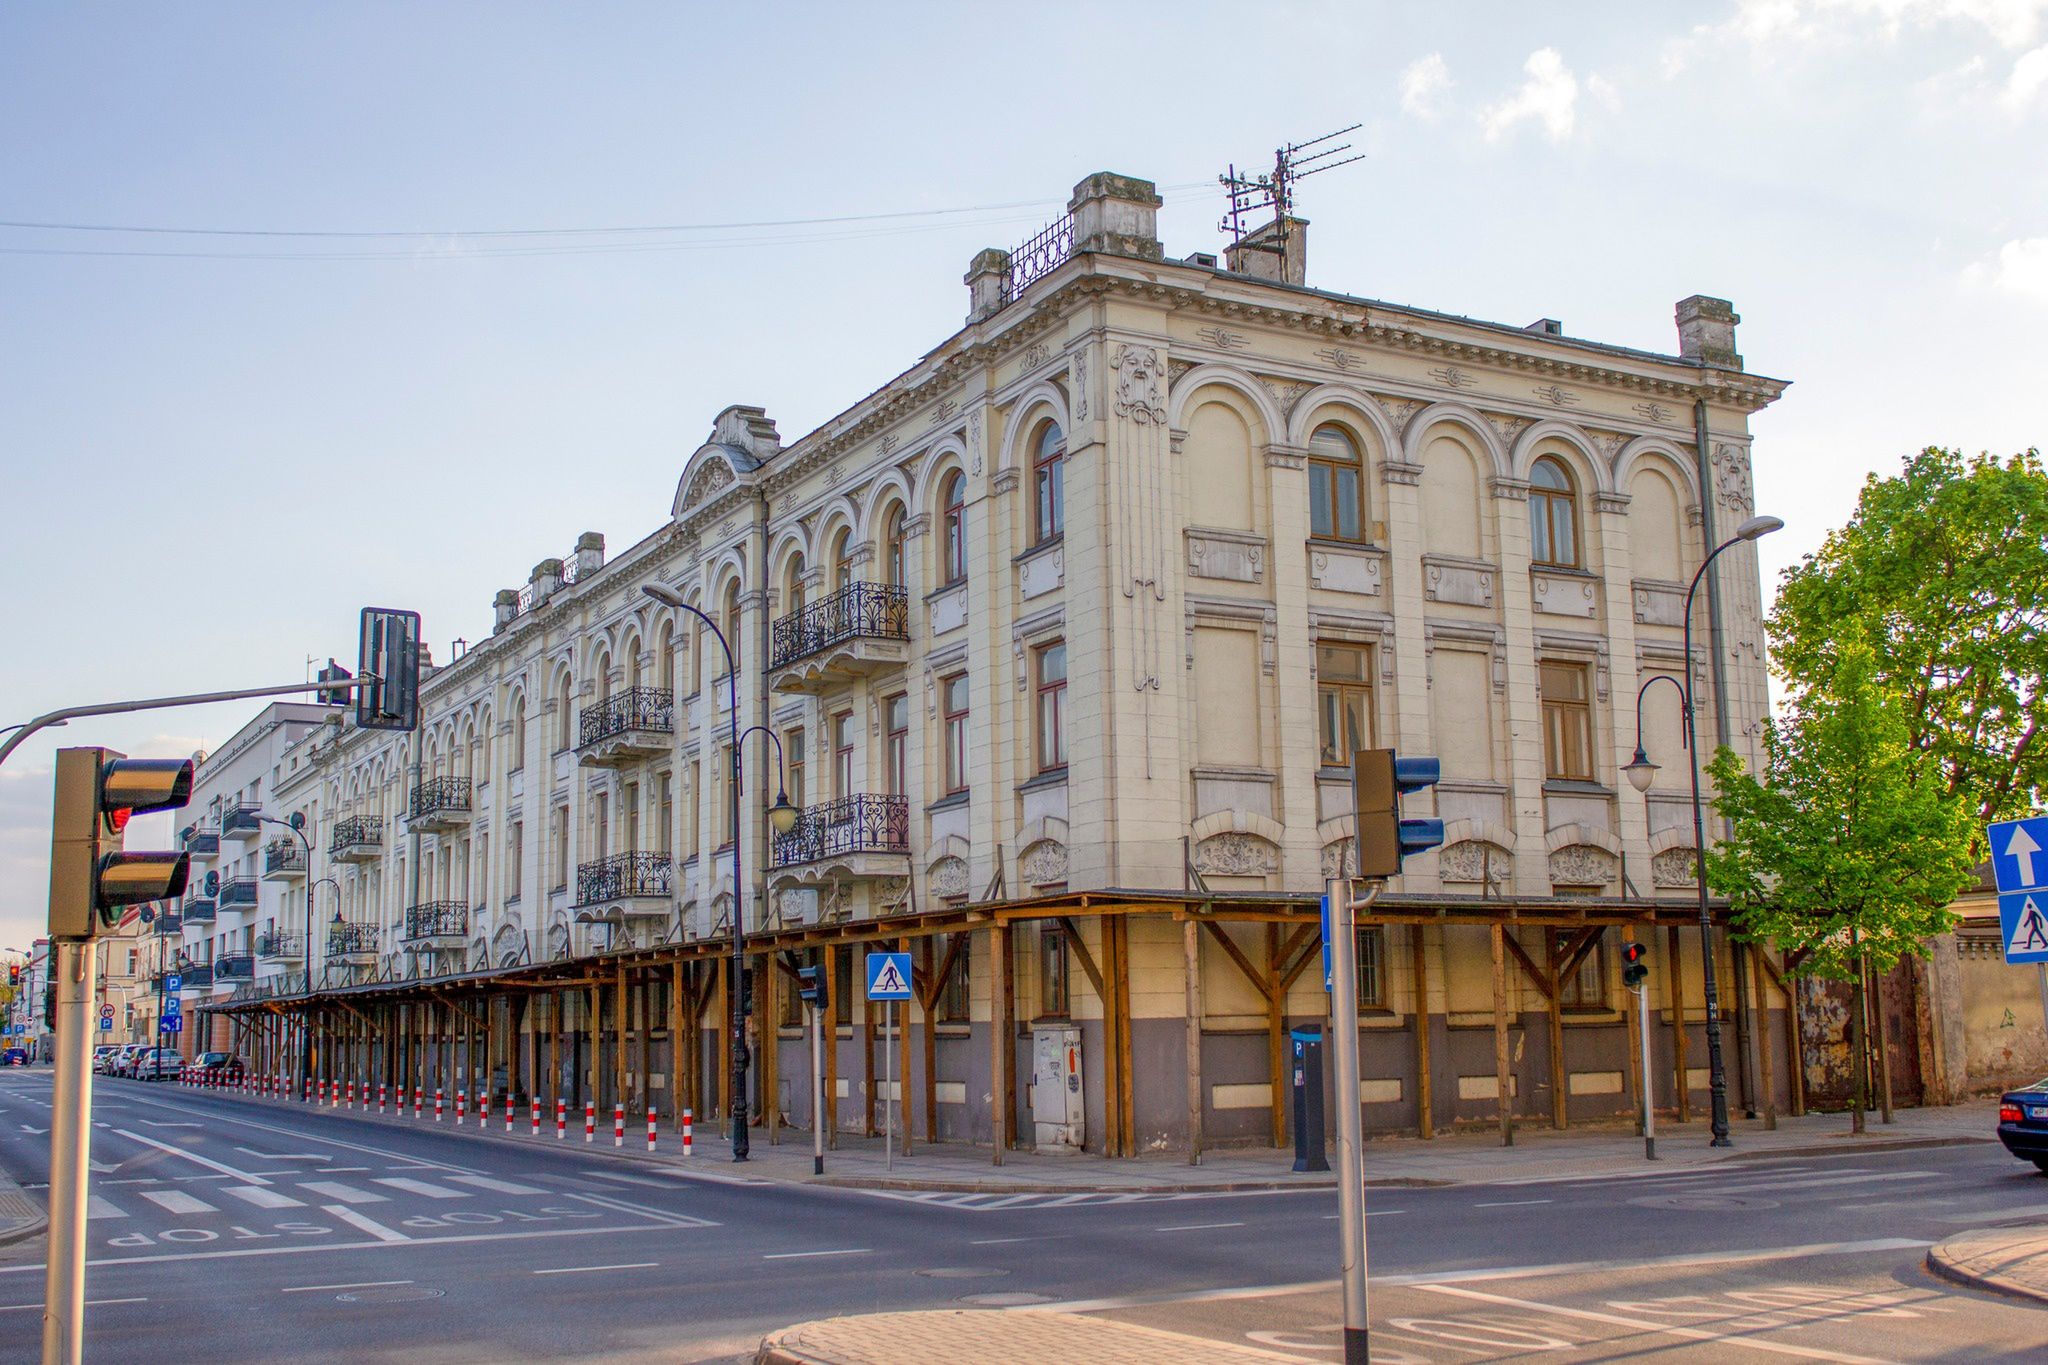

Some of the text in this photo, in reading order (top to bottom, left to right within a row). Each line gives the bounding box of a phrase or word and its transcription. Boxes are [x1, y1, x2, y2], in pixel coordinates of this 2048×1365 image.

[169, 978, 178, 989] P
[168, 999, 177, 1010] P
[103, 1019, 110, 1028] P
[1296, 1042, 1302, 1055] P
[402, 1206, 603, 1227] STOP
[107, 1222, 333, 1247] STOP
